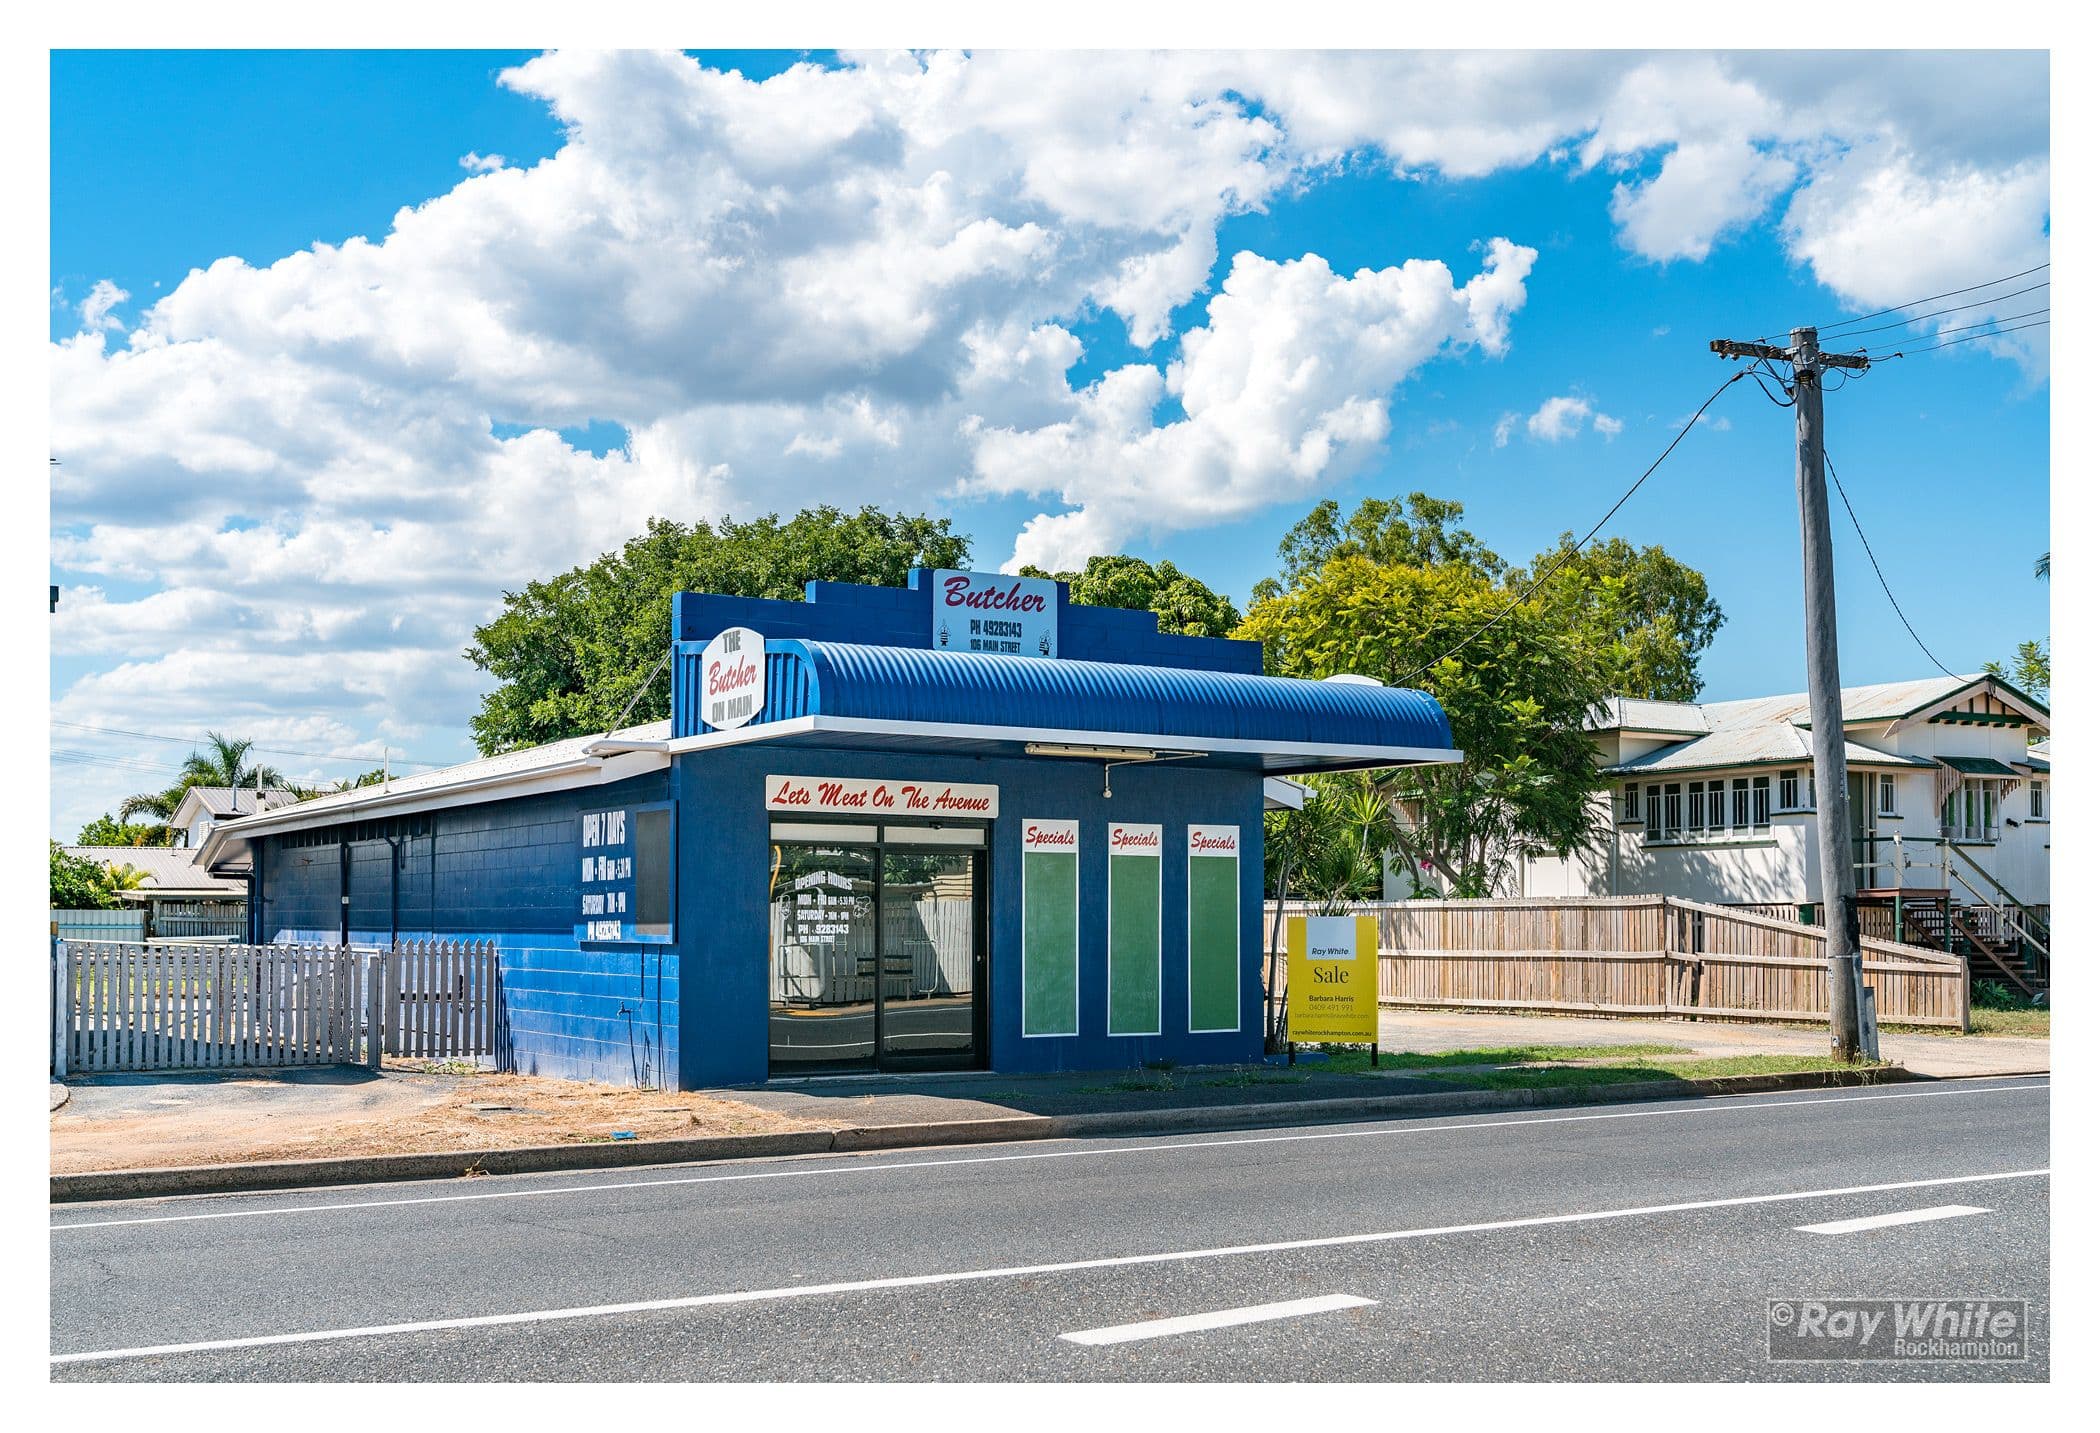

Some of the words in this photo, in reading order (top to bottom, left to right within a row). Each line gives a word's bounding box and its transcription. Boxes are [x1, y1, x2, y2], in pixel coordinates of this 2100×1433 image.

[944, 576, 1046, 612] Butcher
[970, 619, 981, 635] PH
[983, 620, 1022, 638] 49283143
[722, 630, 741, 653] THE
[970, 639, 981, 650] 106
[983, 640, 998, 651] MAIN
[1000, 641, 1020, 653] STREET
[709, 655, 757, 695] Butcher
[712, 701, 725, 723] ON
[728, 694, 752, 719] MAIN
[772, 781, 811, 805] Lets
[818, 782, 867, 808] Meat
[872, 785, 895, 808] On
[901, 786, 929, 809] The
[932, 788, 989, 811] Avenue
[583, 814, 600, 847] OPEN
[601, 812, 606, 846] 7
[607, 810, 625, 845] DAYS
[1025, 826, 1075, 848] Specials
[1111, 828, 1159, 849] Specials
[1190, 831, 1236, 852] Specials
[795, 870, 826, 890] OPENING
[828, 871, 852, 890] HOURS
[797, 894, 811, 905] MON
[817, 894, 827, 905] FRI
[797, 909, 825, 920] SATURDAY
[798, 924, 808, 934] PH
[812, 924, 849, 934] 9283143
[821, 935, 835, 943] STREET
[1312, 948, 1326, 956] Ray
[1314, 965, 1349, 983] Sale
[1292, 1029, 1372, 1037] raywhiterockhampton.com.au
